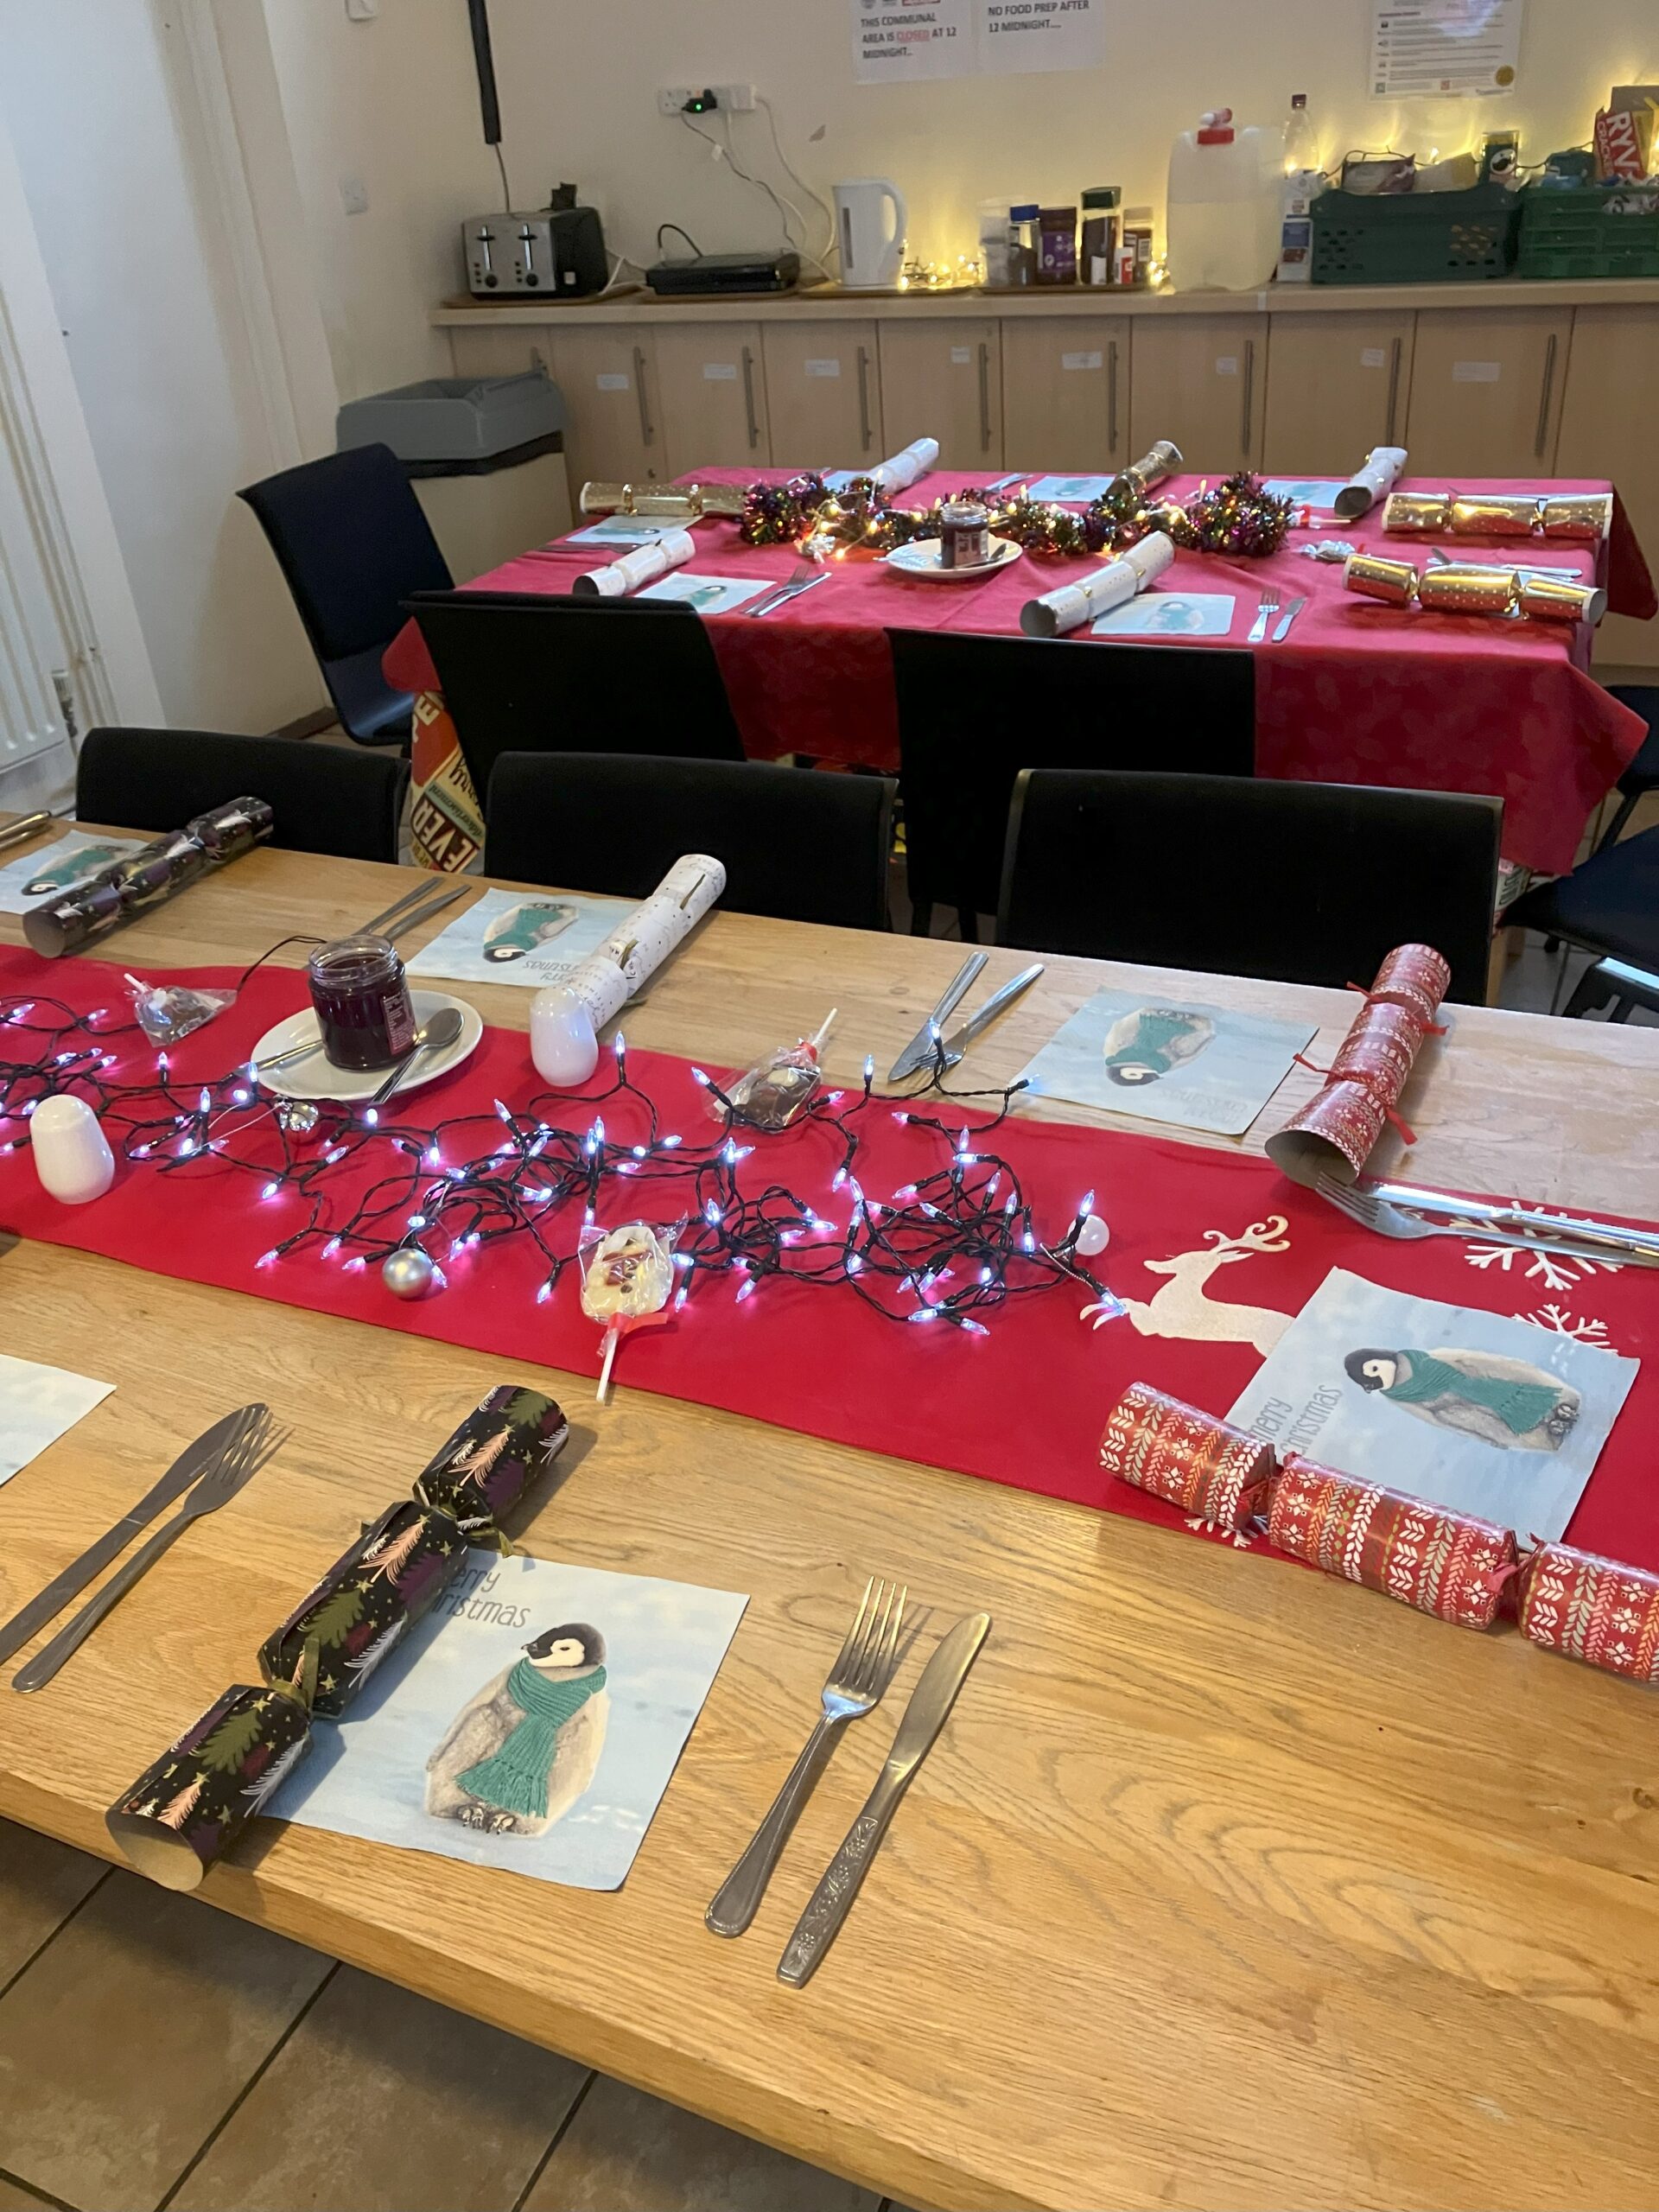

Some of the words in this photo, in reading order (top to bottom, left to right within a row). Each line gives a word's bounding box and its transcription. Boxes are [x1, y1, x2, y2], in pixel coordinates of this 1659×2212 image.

[988, 7, 1002, 16] NO
[1005, 4, 1032, 15] FOOD
[1034, 3, 1058, 13] PREP
[1059, 0, 1090, 10] AFTER
[861, 17, 880, 28] THIS
[881, 13, 936, 26] COMMUNAL
[988, 22, 999, 32] 12
[862, 33, 885, 43] AREA
[887, 32, 894, 41] IS
[897, 30, 930, 43] CLOSED
[932, 28, 944, 37] AT
[946, 26, 957, 36] 12
[1606, 111, 1641, 168] RYV
[448, 1567, 501, 1593] erry
[432, 1593, 531, 1628] ristmas
